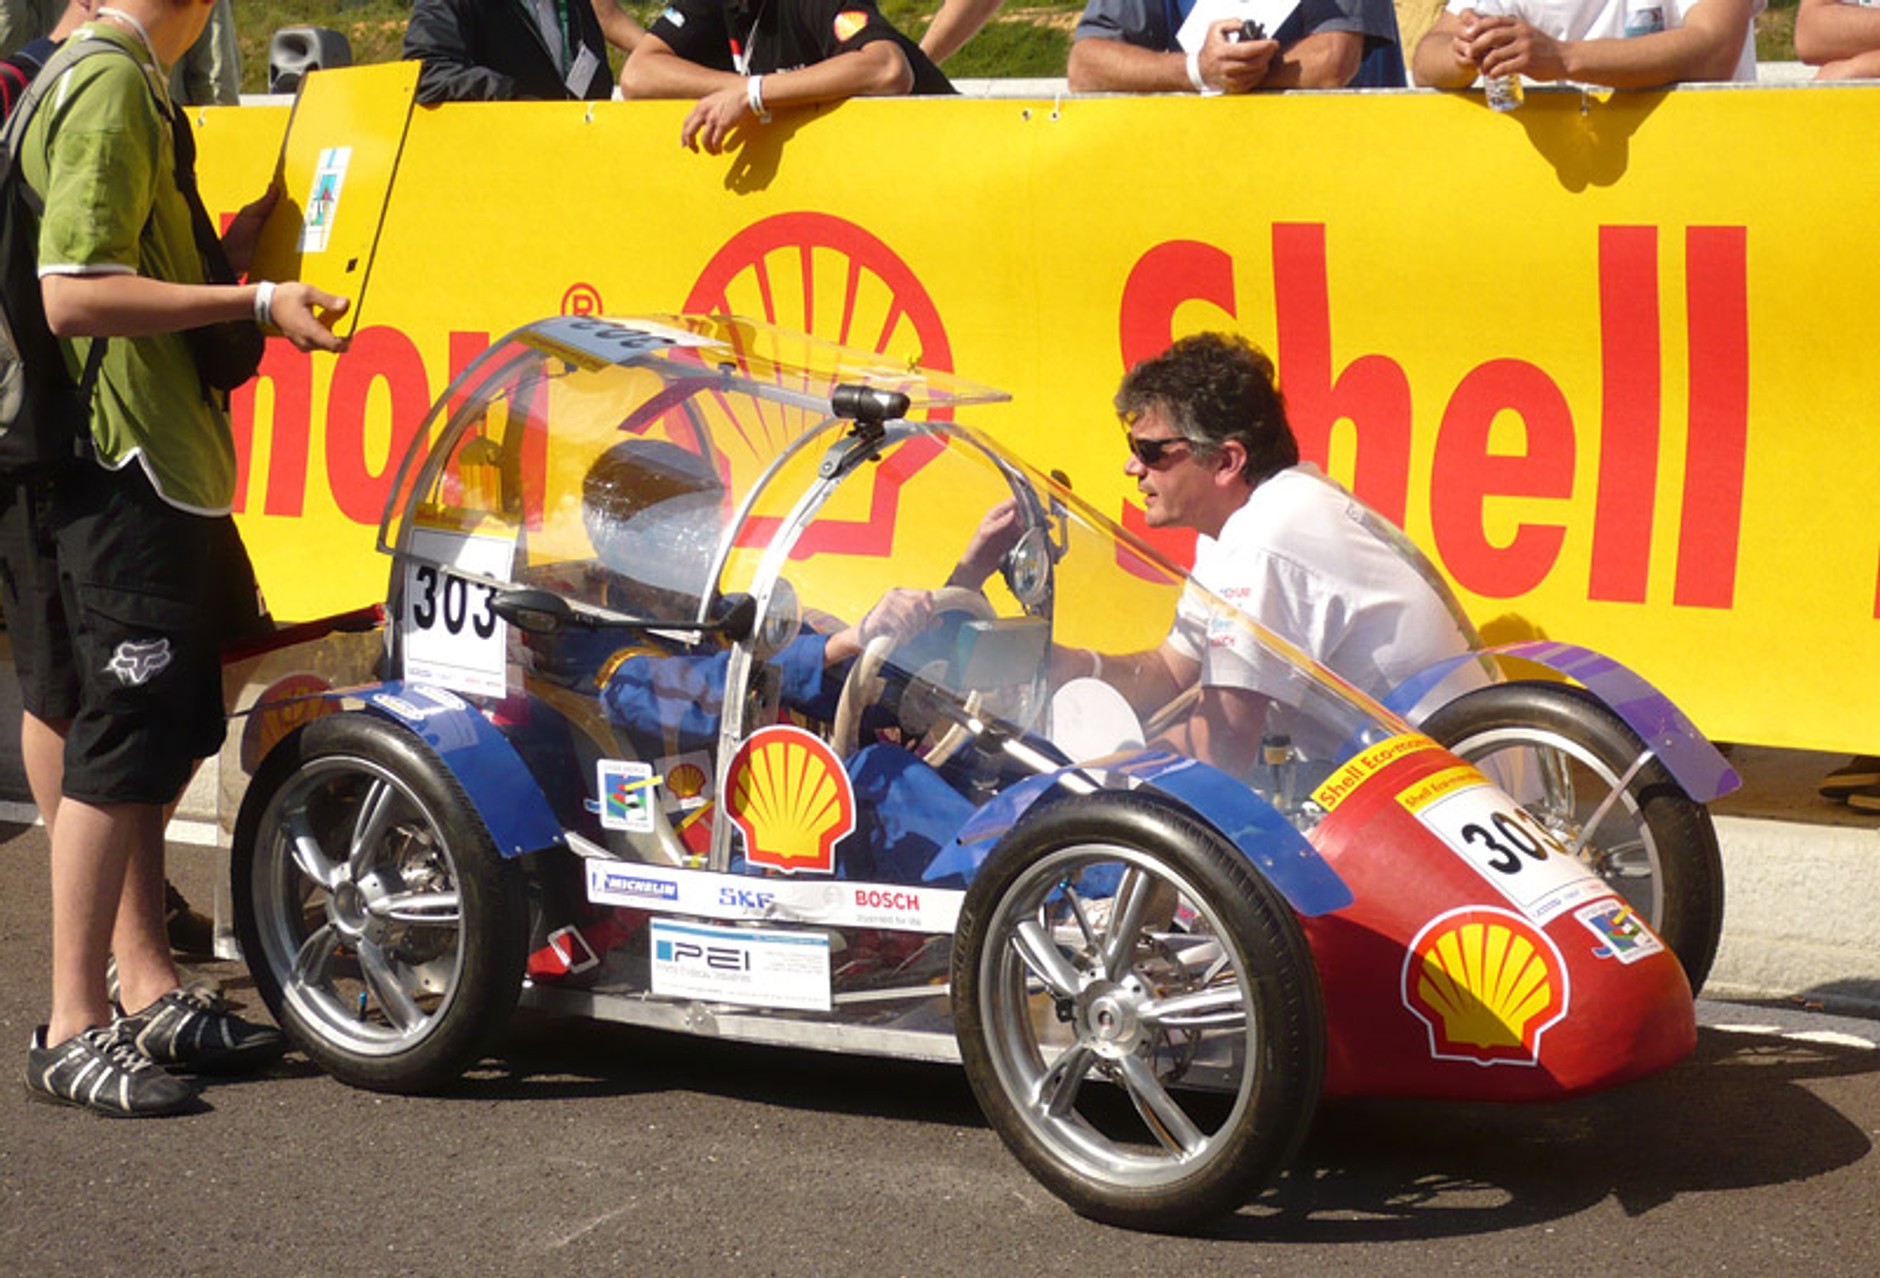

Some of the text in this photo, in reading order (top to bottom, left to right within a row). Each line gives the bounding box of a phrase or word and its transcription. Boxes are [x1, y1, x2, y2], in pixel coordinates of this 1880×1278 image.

[1115, 222, 1749, 609] Shell
[413, 565, 498, 640] 303
[1318, 765, 1365, 807] Shell
[608, 877, 920, 911] MICHELIN SKF BOSCH
[674, 941, 750, 971] PEI
